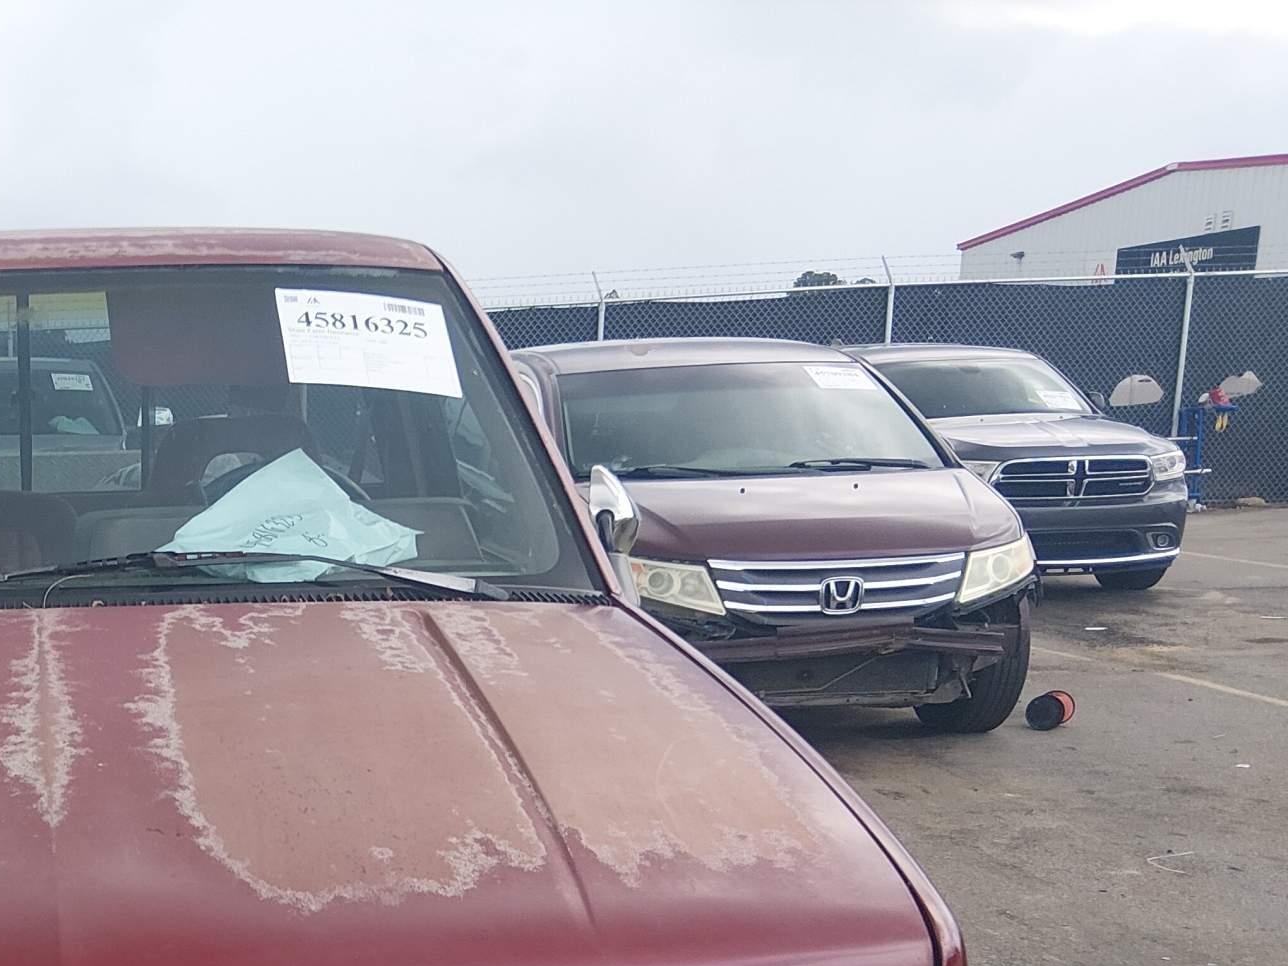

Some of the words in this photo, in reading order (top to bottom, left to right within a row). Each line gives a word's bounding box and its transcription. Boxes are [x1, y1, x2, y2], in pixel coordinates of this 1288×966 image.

[1150, 251, 1167, 268] IAA
[1168, 247, 1215, 265] Lexngton
[297, 311, 428, 338] 45816325
